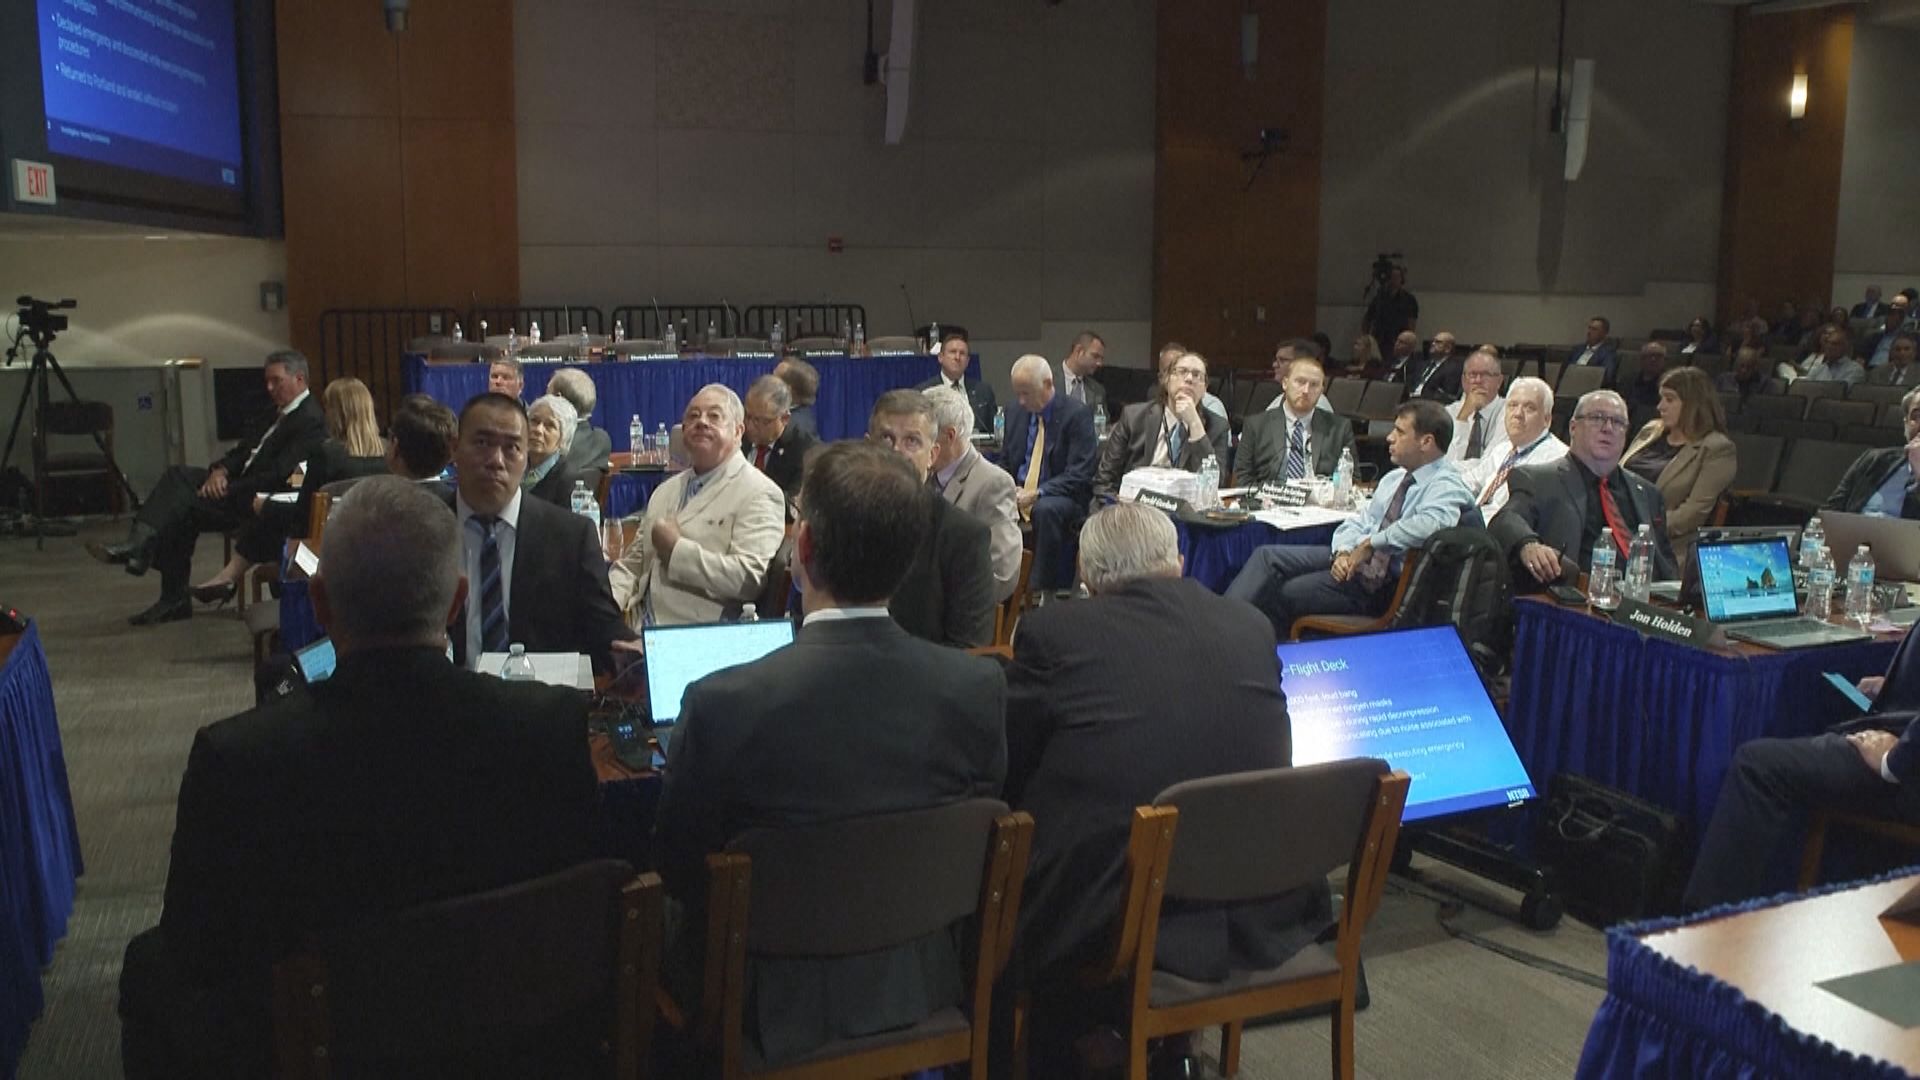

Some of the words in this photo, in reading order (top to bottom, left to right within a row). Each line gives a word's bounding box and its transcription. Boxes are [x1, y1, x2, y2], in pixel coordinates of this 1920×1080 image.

[27, 165, 48, 198] EXIT
[1629, 609, 1651, 625] Jon
[1651, 615, 1692, 638] Holden
[1321, 658, 1349, 672] Deck
[1339, 689, 1358, 699] bang
[1342, 701, 1369, 713] oxygen
[1369, 698, 1393, 709] masks
[1369, 711, 1387, 722] rapid
[1387, 705, 1440, 719] decompression
[1400, 722, 1420, 734] noise
[1420, 716, 1457, 730] associated
[1393, 746, 1428, 758] executing
[1427, 740, 1465, 754] emergency
[1505, 787, 1531, 802] NTSB
